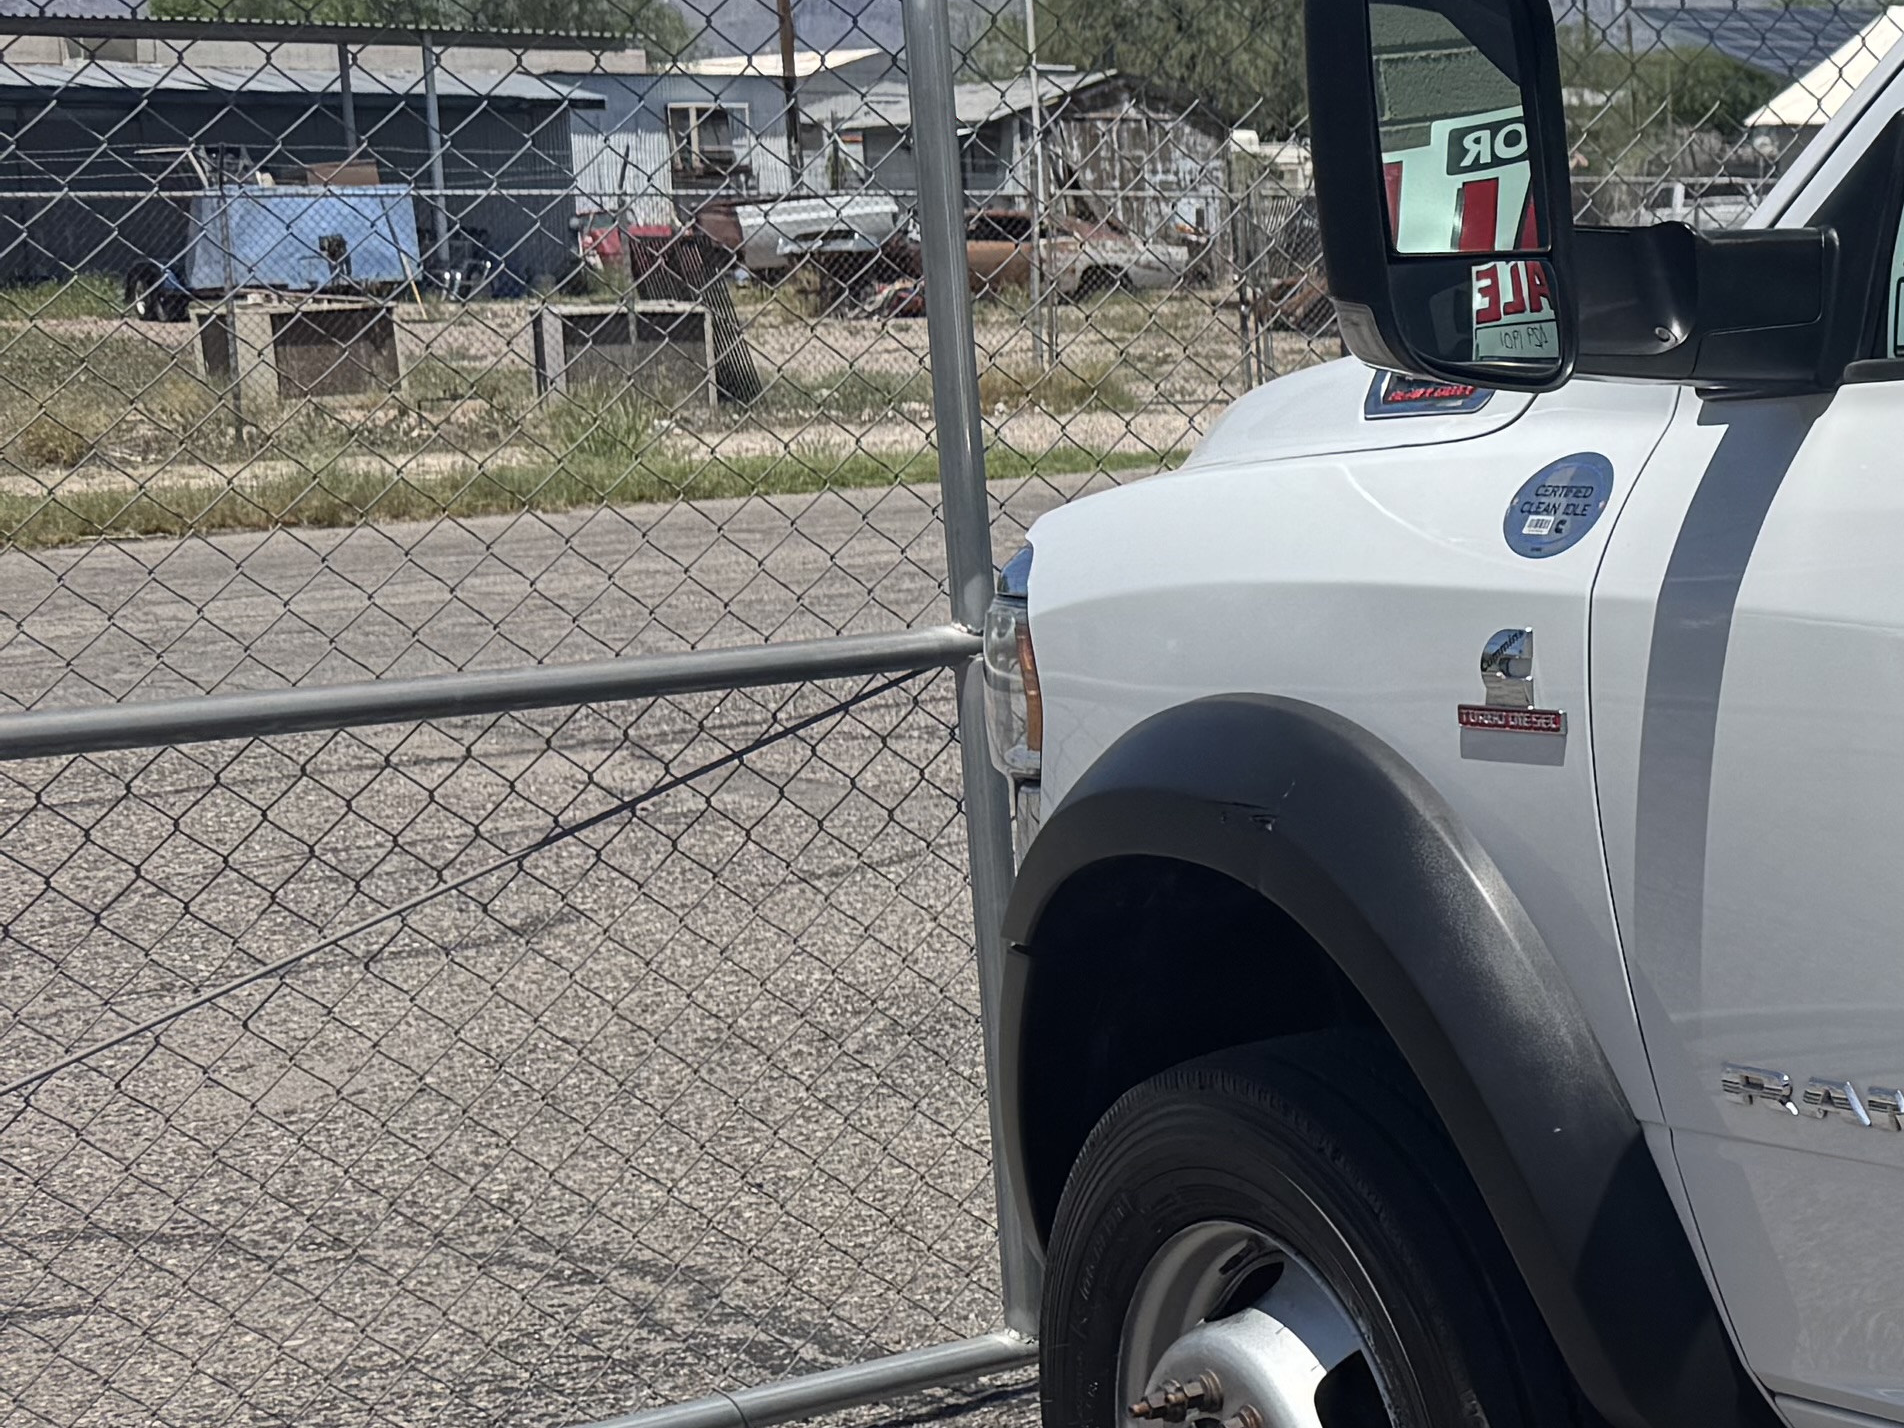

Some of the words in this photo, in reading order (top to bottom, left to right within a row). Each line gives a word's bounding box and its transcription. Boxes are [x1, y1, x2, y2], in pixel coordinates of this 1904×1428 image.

[1535, 484, 1594, 499] CERTIFIED
[1520, 501, 1561, 516] CLEAN
[1562, 503, 1592, 517] IDLE
[1508, 711, 1557, 729] DIESEL
